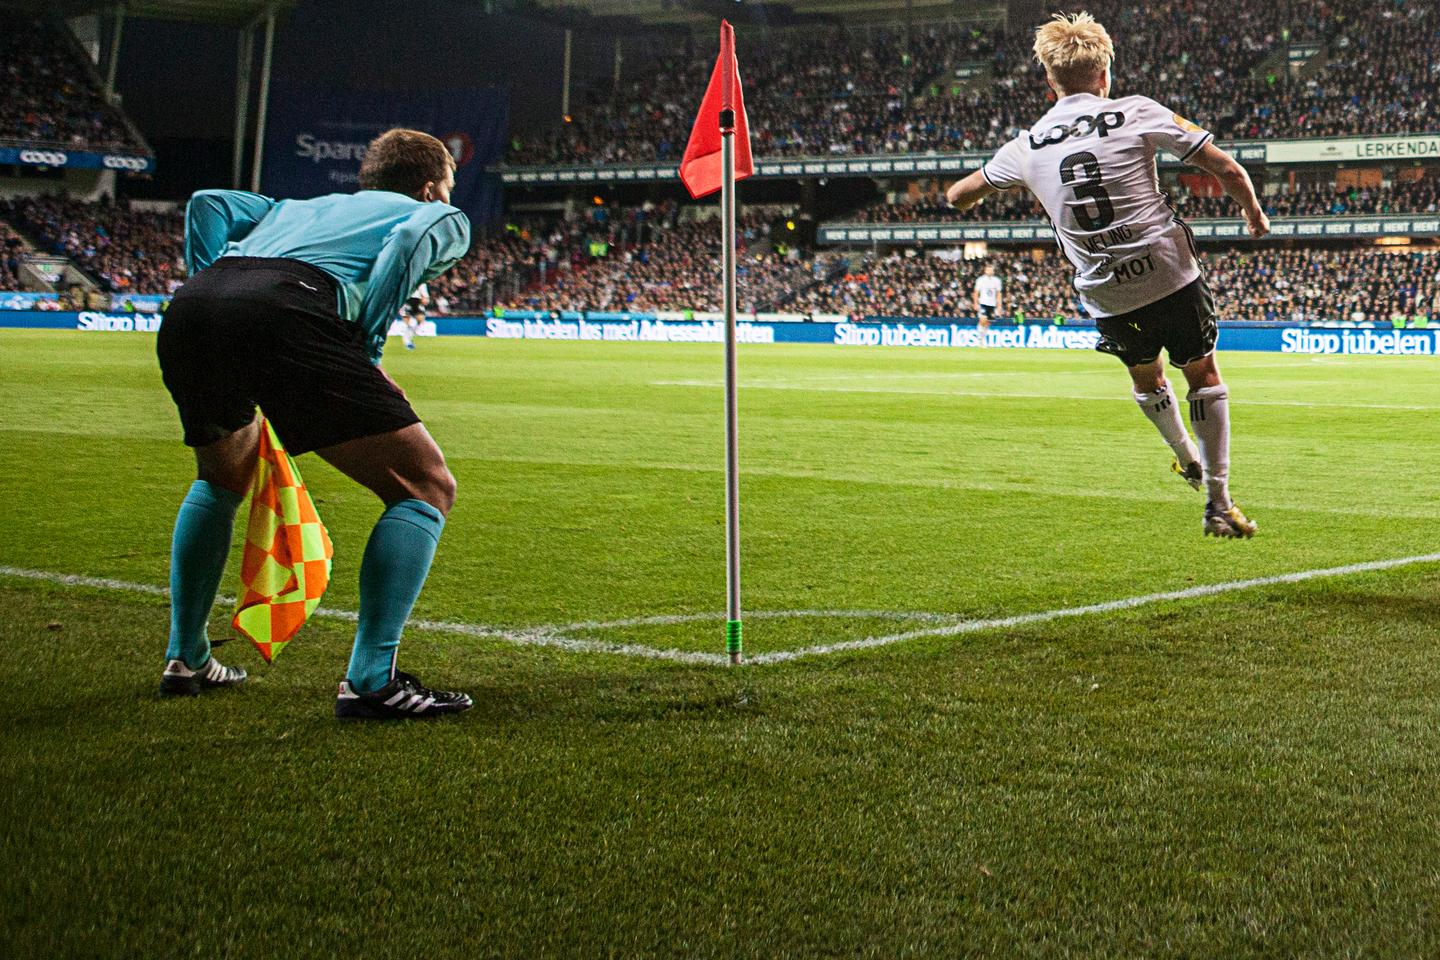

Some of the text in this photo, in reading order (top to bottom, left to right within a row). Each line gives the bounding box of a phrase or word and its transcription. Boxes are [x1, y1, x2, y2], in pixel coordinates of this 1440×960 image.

[19, 150, 149, 172] coop coop
[1059, 151, 1115, 232] 3
[1412, 220, 1440, 232] HENT
[1113, 251, 1155, 284] MOT
[833, 323, 880, 346] Slipp
[881, 324, 949, 347] jubelen
[983, 325, 1025, 348] med
[1281, 328, 1341, 354] Slipp
[1342, 329, 1432, 355] jubelen
